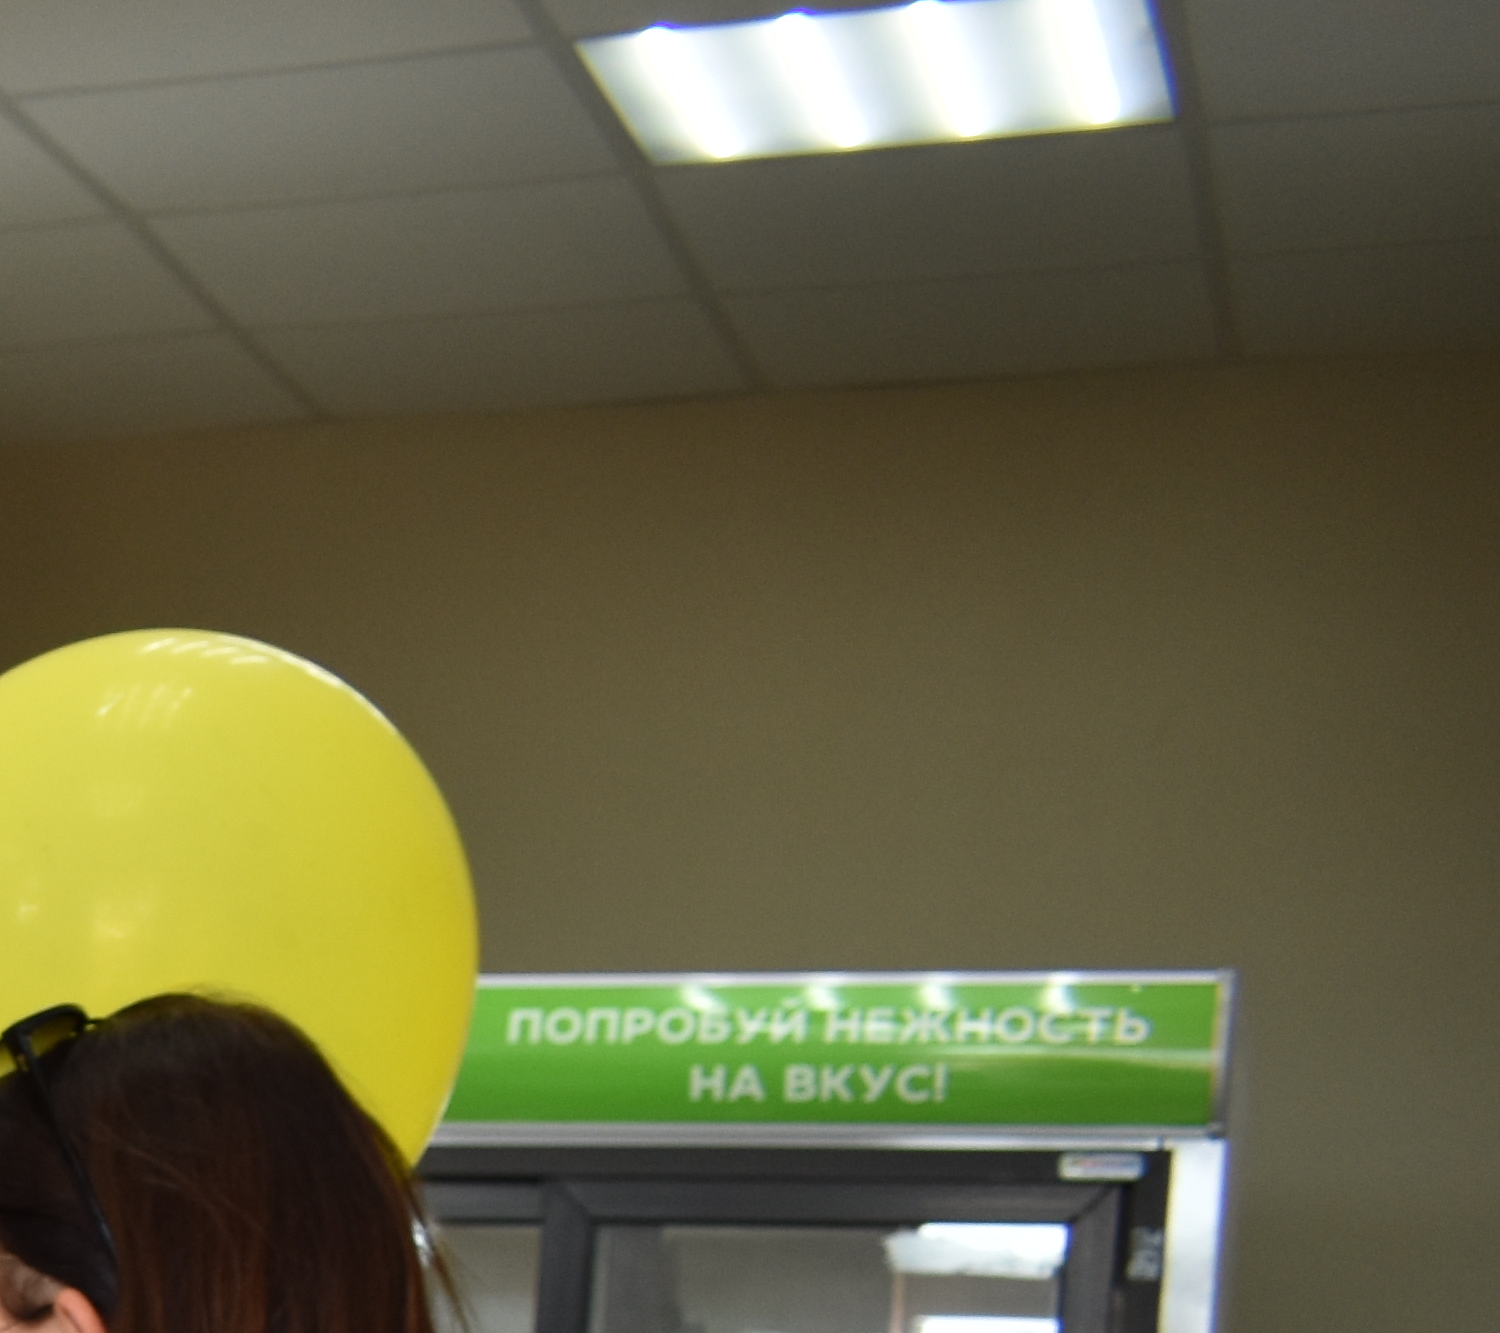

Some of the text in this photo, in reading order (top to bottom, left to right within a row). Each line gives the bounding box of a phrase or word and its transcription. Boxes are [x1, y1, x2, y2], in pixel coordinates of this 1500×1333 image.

[507, 999, 1151, 1045] ПОПРОБУЙ НЕЖНОСТЬ
[688, 1063, 949, 1102] НА ВКУС!
